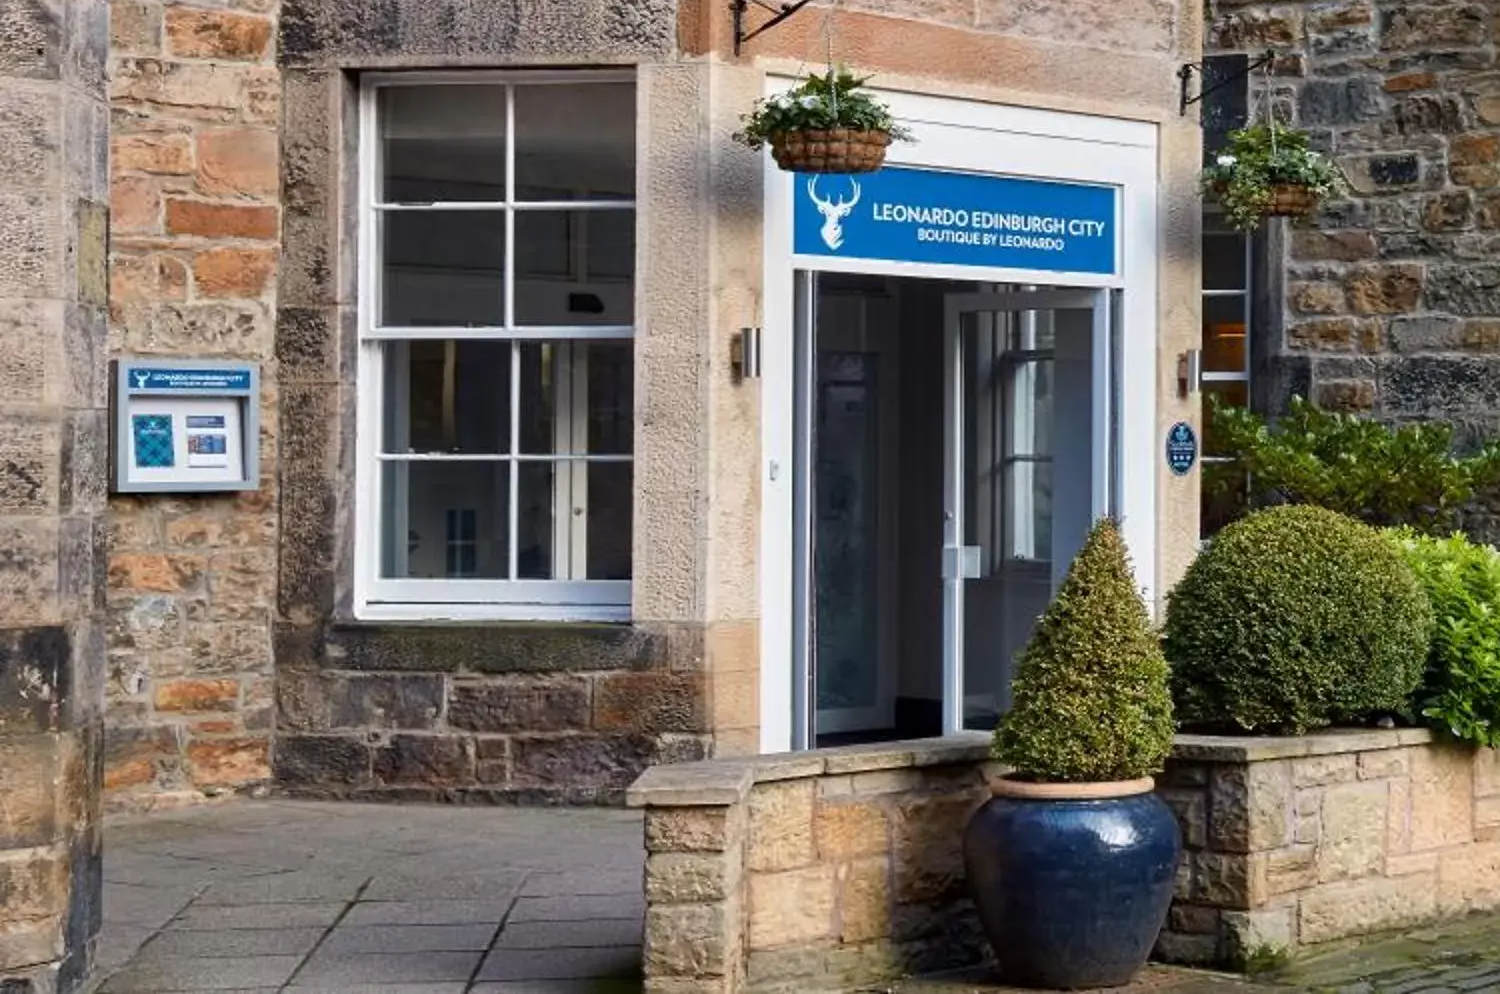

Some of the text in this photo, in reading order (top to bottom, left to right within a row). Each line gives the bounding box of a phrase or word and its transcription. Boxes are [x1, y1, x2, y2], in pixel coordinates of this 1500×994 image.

[873, 202, 1105, 237] LEONARDO EDINBURGH CITY
[918, 228, 1065, 251] BOUTIQUE BY LEONARDO
